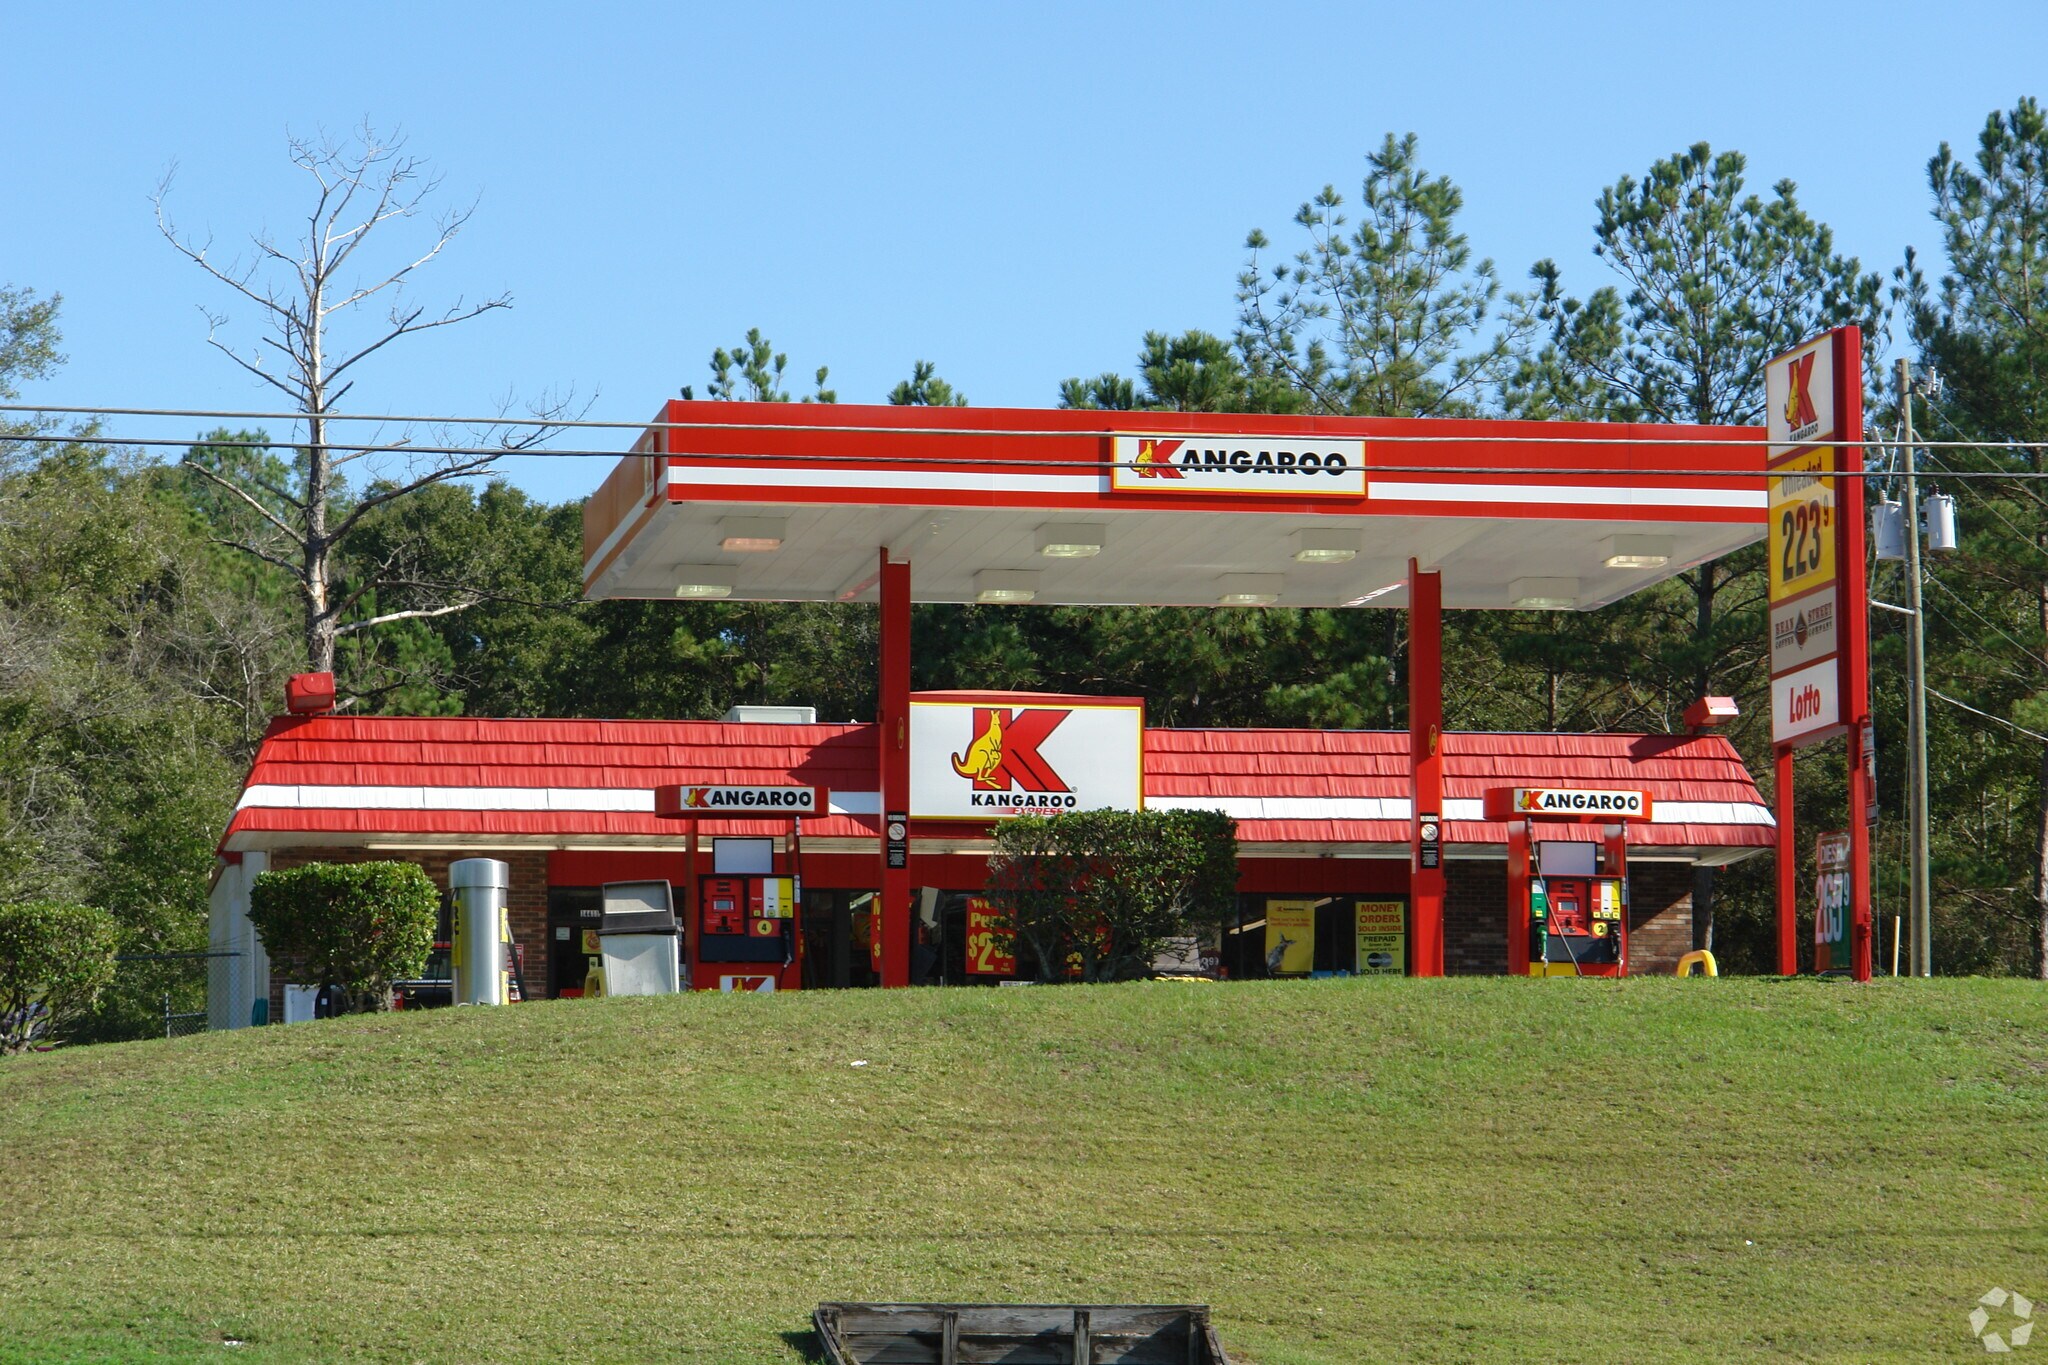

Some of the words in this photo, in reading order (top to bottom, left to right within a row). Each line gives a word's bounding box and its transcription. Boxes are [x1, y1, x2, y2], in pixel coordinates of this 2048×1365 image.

[1138, 439, 1347, 479] KANGAROO
[1789, 684, 1820, 723] Lotto
[688, 788, 812, 807] KANGAROO
[971, 794, 1077, 807] KANGAROO
[1522, 791, 1639, 810] KANGAROO
[1361, 904, 1399, 912] MONEY
[1360, 914, 1401, 923] ORDERS
[761, 923, 767, 932] 4
[1598, 925, 1604, 933] 2
